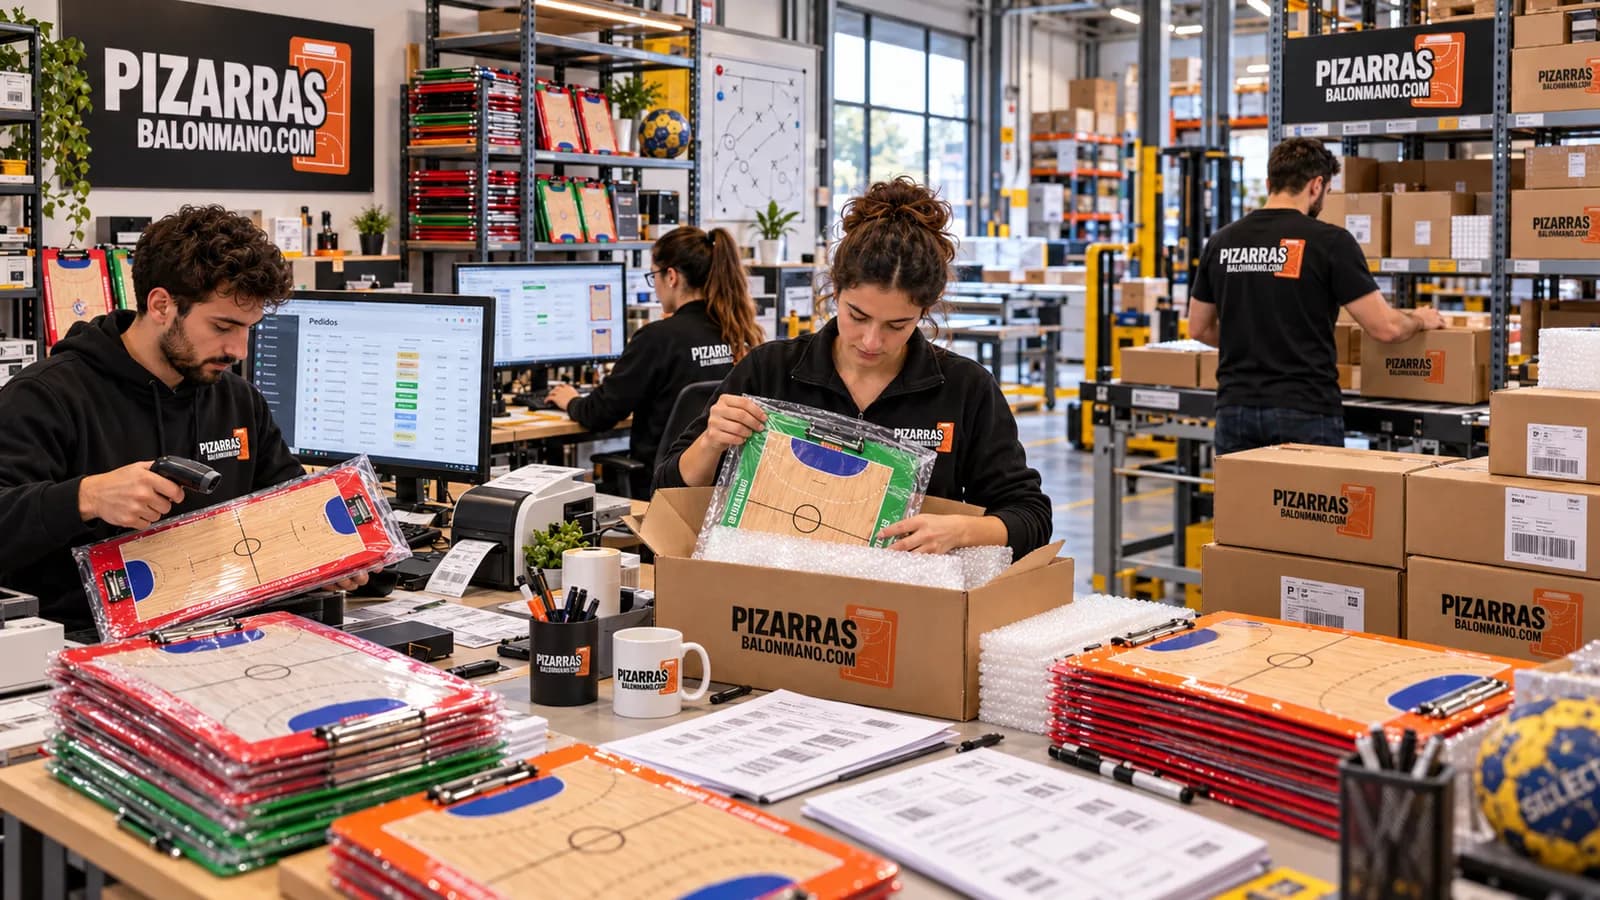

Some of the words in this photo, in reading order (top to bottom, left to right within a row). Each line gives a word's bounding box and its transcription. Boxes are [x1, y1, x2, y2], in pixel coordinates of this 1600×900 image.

[1315, 49, 1433, 87] PIZARRAS
[1538, 67, 1593, 83] PIZARRAS
[104, 47, 326, 126] PIZARRAS
[1325, 81, 1430, 102] BALONMANO.COM
[137, 118, 315, 155] BALONMANO.COM
[1532, 215, 1590, 230] PIZARRAS
[1220, 247, 1287, 264] PIZARRAS
[309, 317, 338, 326] Pedidos
[1385, 358, 1432, 369] PIZARRAS
[894, 428, 943, 441] PIZARRAS
[199, 437, 241, 455] PIZARRAS
[1273, 489, 1349, 515] PIZARRAS
[1280, 508, 1346, 525] BALONMANO.COM
[1441, 593, 1546, 630] PIZARRAS
[732, 605, 858, 649] PIZARRAS
[1454, 618, 1542, 642] BALONMANO.COM
[536, 653, 582, 667] PIZARRAS
[741, 636, 856, 667] BALONMANO.COM
[617, 668, 668, 683] PIZARRAS
